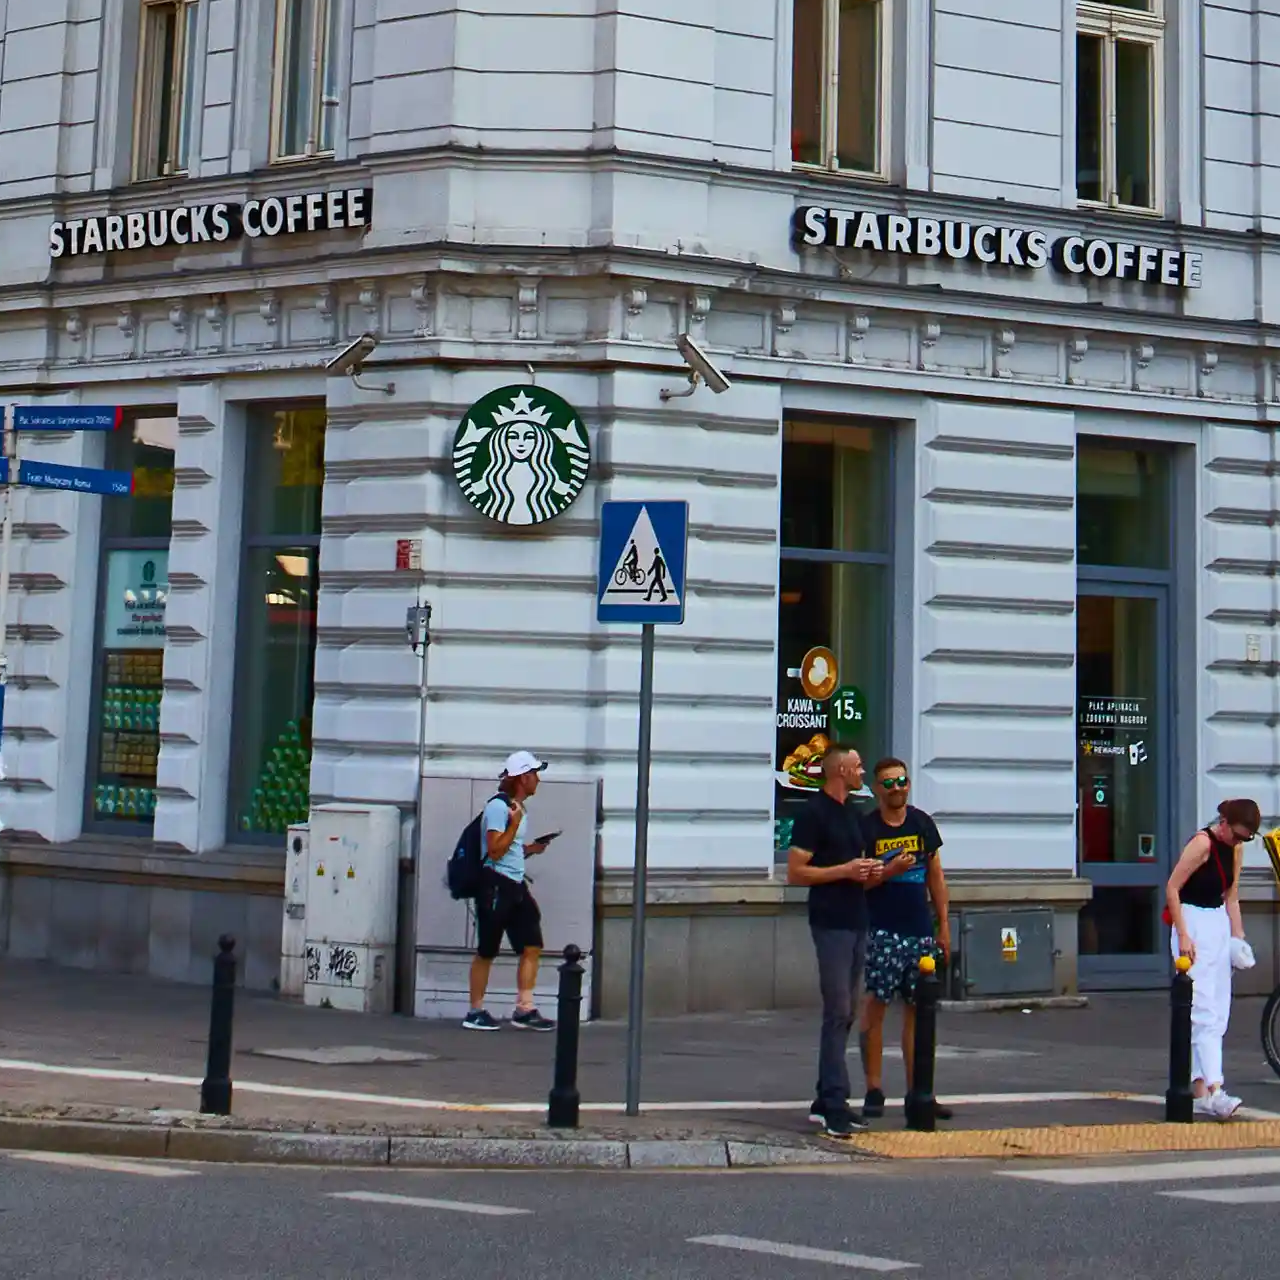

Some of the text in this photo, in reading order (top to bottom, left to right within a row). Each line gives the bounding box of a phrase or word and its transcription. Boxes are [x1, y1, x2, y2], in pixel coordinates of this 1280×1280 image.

[49, 189, 366, 257] STARBUCKS COFFEE
[803, 206, 1202, 288] STARBUCKS COFFEE
[787, 699, 813, 713] KAWA
[834, 699, 854, 720] 15
[777, 713, 828, 728] CROISSANT
[877, 839, 916, 852] LACOST
